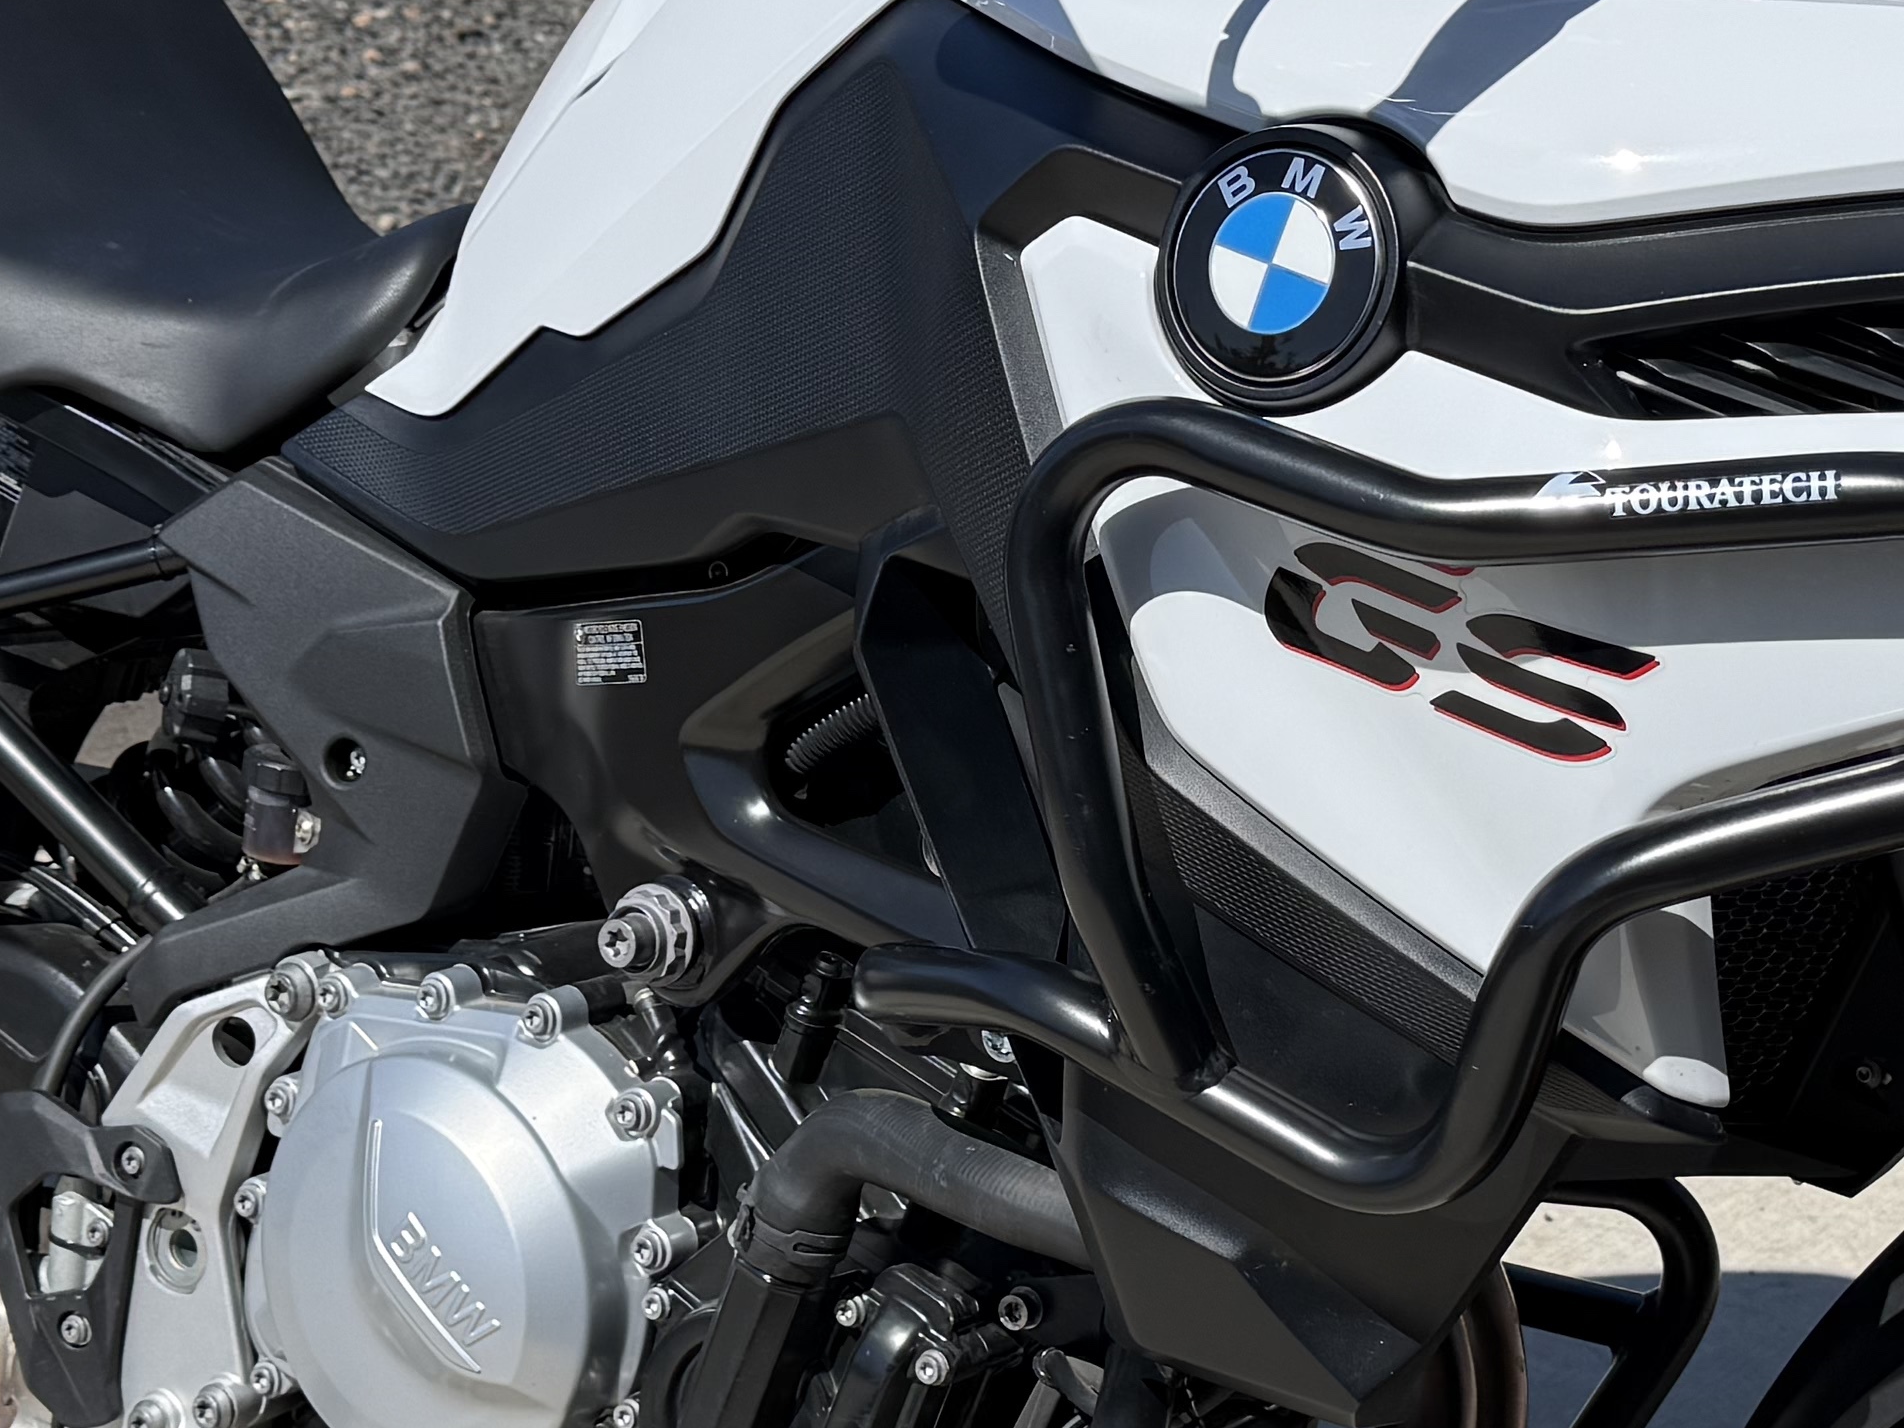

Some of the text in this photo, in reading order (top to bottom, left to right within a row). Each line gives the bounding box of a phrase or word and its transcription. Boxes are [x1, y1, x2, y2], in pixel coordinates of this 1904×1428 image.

[1216, 156, 1373, 253] BMW
[1604, 469, 1840, 517] TOURATECH
[1264, 541, 1661, 762] GS
[390, 1211, 501, 1347] BMW
